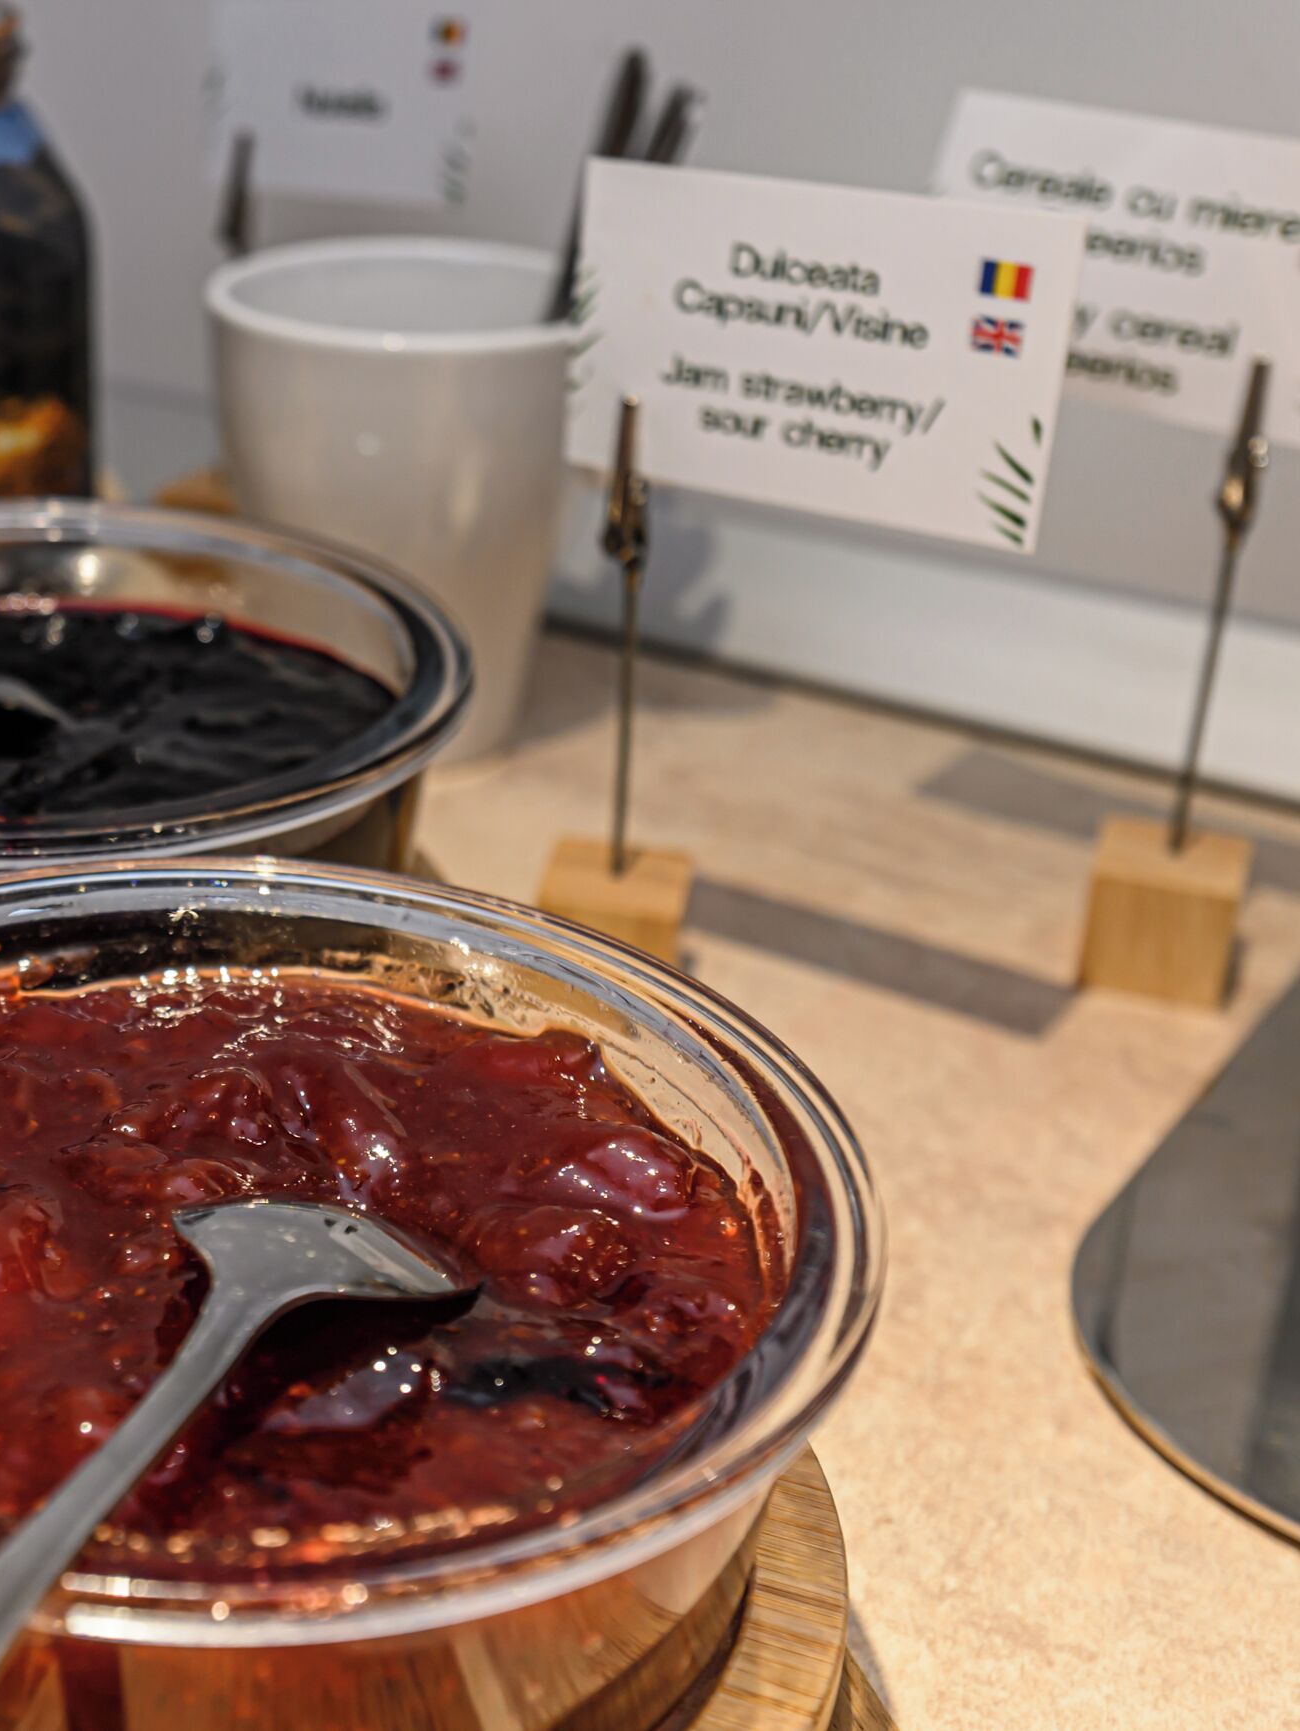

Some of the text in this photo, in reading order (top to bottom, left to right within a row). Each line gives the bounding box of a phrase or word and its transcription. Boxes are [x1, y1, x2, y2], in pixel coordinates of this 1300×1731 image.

[970, 150, 1300, 244] Cereale cu miere
[729, 242, 881, 296] Dulceata
[1086, 229, 1205, 276] eerios
[673, 278, 929, 349] Capsuni/Visine
[1107, 310, 1239, 358] cereal
[660, 354, 946, 436] Jam strawberry/
[1066, 352, 1180, 396] eerios
[699, 405, 891, 471] sour cherry
